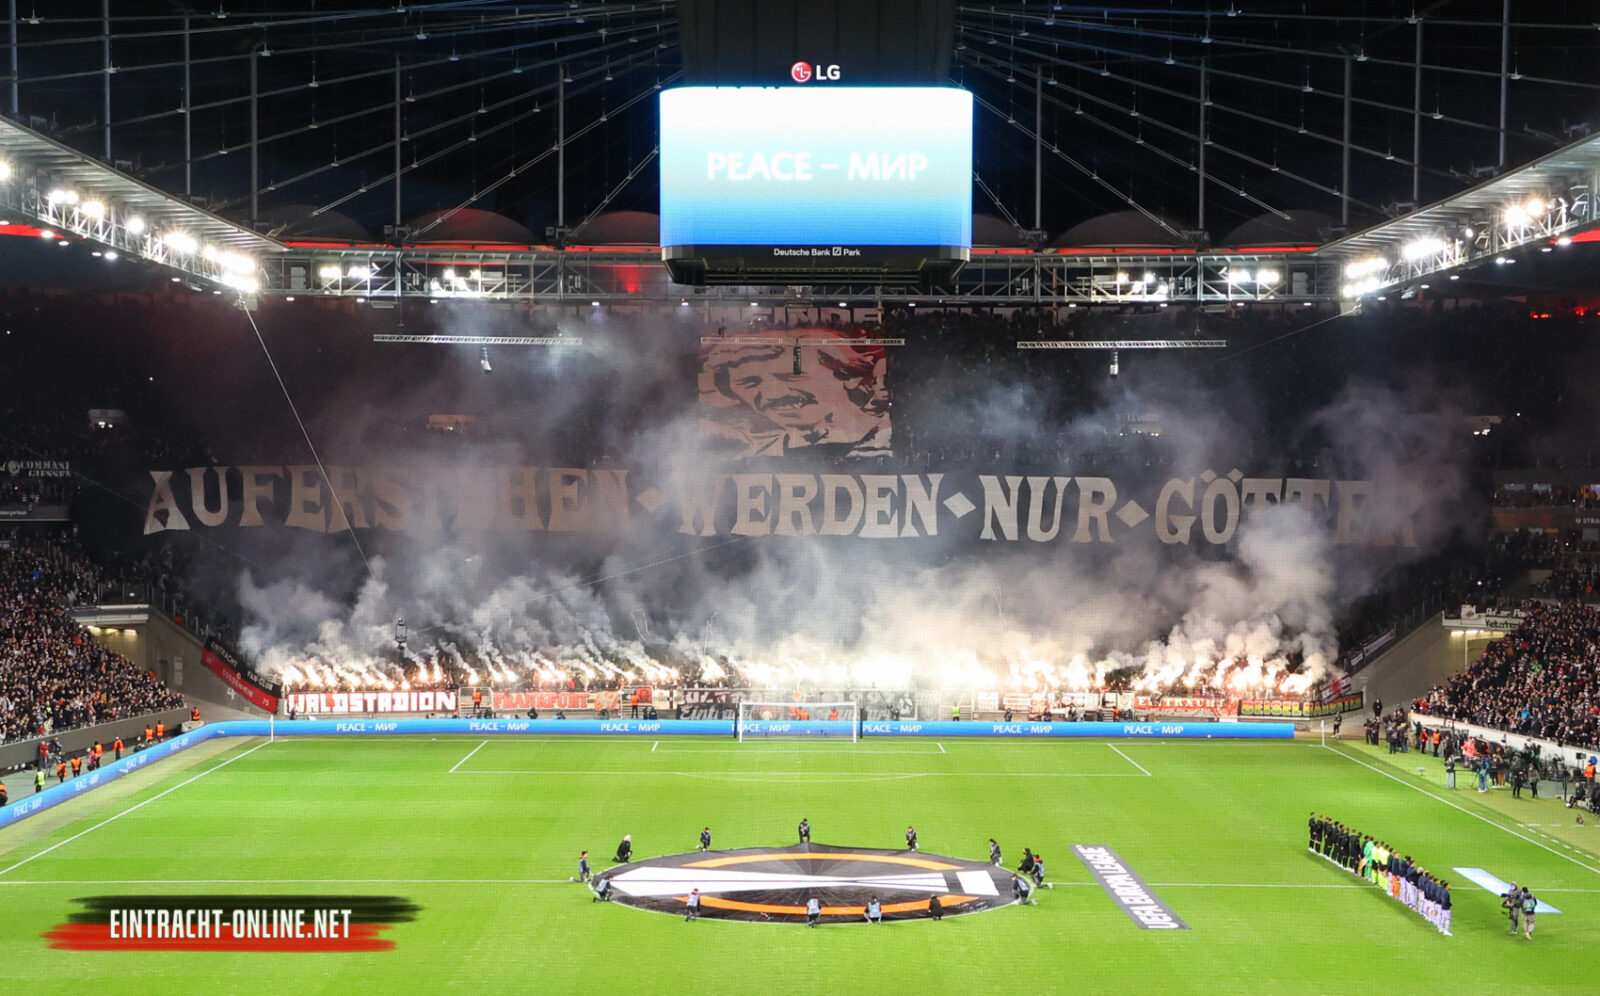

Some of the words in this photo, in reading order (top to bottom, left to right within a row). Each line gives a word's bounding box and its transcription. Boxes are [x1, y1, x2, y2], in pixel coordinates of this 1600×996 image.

[816, 64, 840, 80] LG
[707, 151, 813, 181] PEACE
[847, 151, 928, 181] МИР
[774, 248, 810, 256] Deutsche
[811, 248, 831, 256] Bank
[843, 248, 861, 256] Park
[143, 465, 630, 535] AUFERSHEN
[676, 473, 945, 538] WERDEN
[979, 475, 1118, 543] NUR
[210, 641, 238, 667] EINTRACHT
[247, 670, 274, 690] FAN-CLUB
[288, 691, 457, 713] WALDSTADION
[493, 691, 590, 710] FRANKFURT
[336, 722, 366, 732] PEACE
[375, 722, 398, 731] МИР
[470, 722, 499, 731] PEACE
[507, 722, 530, 731] МИР
[600, 722, 629, 731] PEACE
[638, 722, 661, 732] МИР
[769, 723, 791, 733] МИР
[863, 723, 891, 733] PEACE
[900, 723, 922, 733] МИР
[993, 724, 1022, 734] PEACE
[1031, 724, 1053, 734] МИР
[1124, 725, 1152, 734] PEACE
[1162, 725, 1184, 734] МИР
[1077, 844, 1128, 874] LEAGUE
[1102, 874, 1155, 904] EUROPA
[1129, 905, 1179, 929] UEFA
